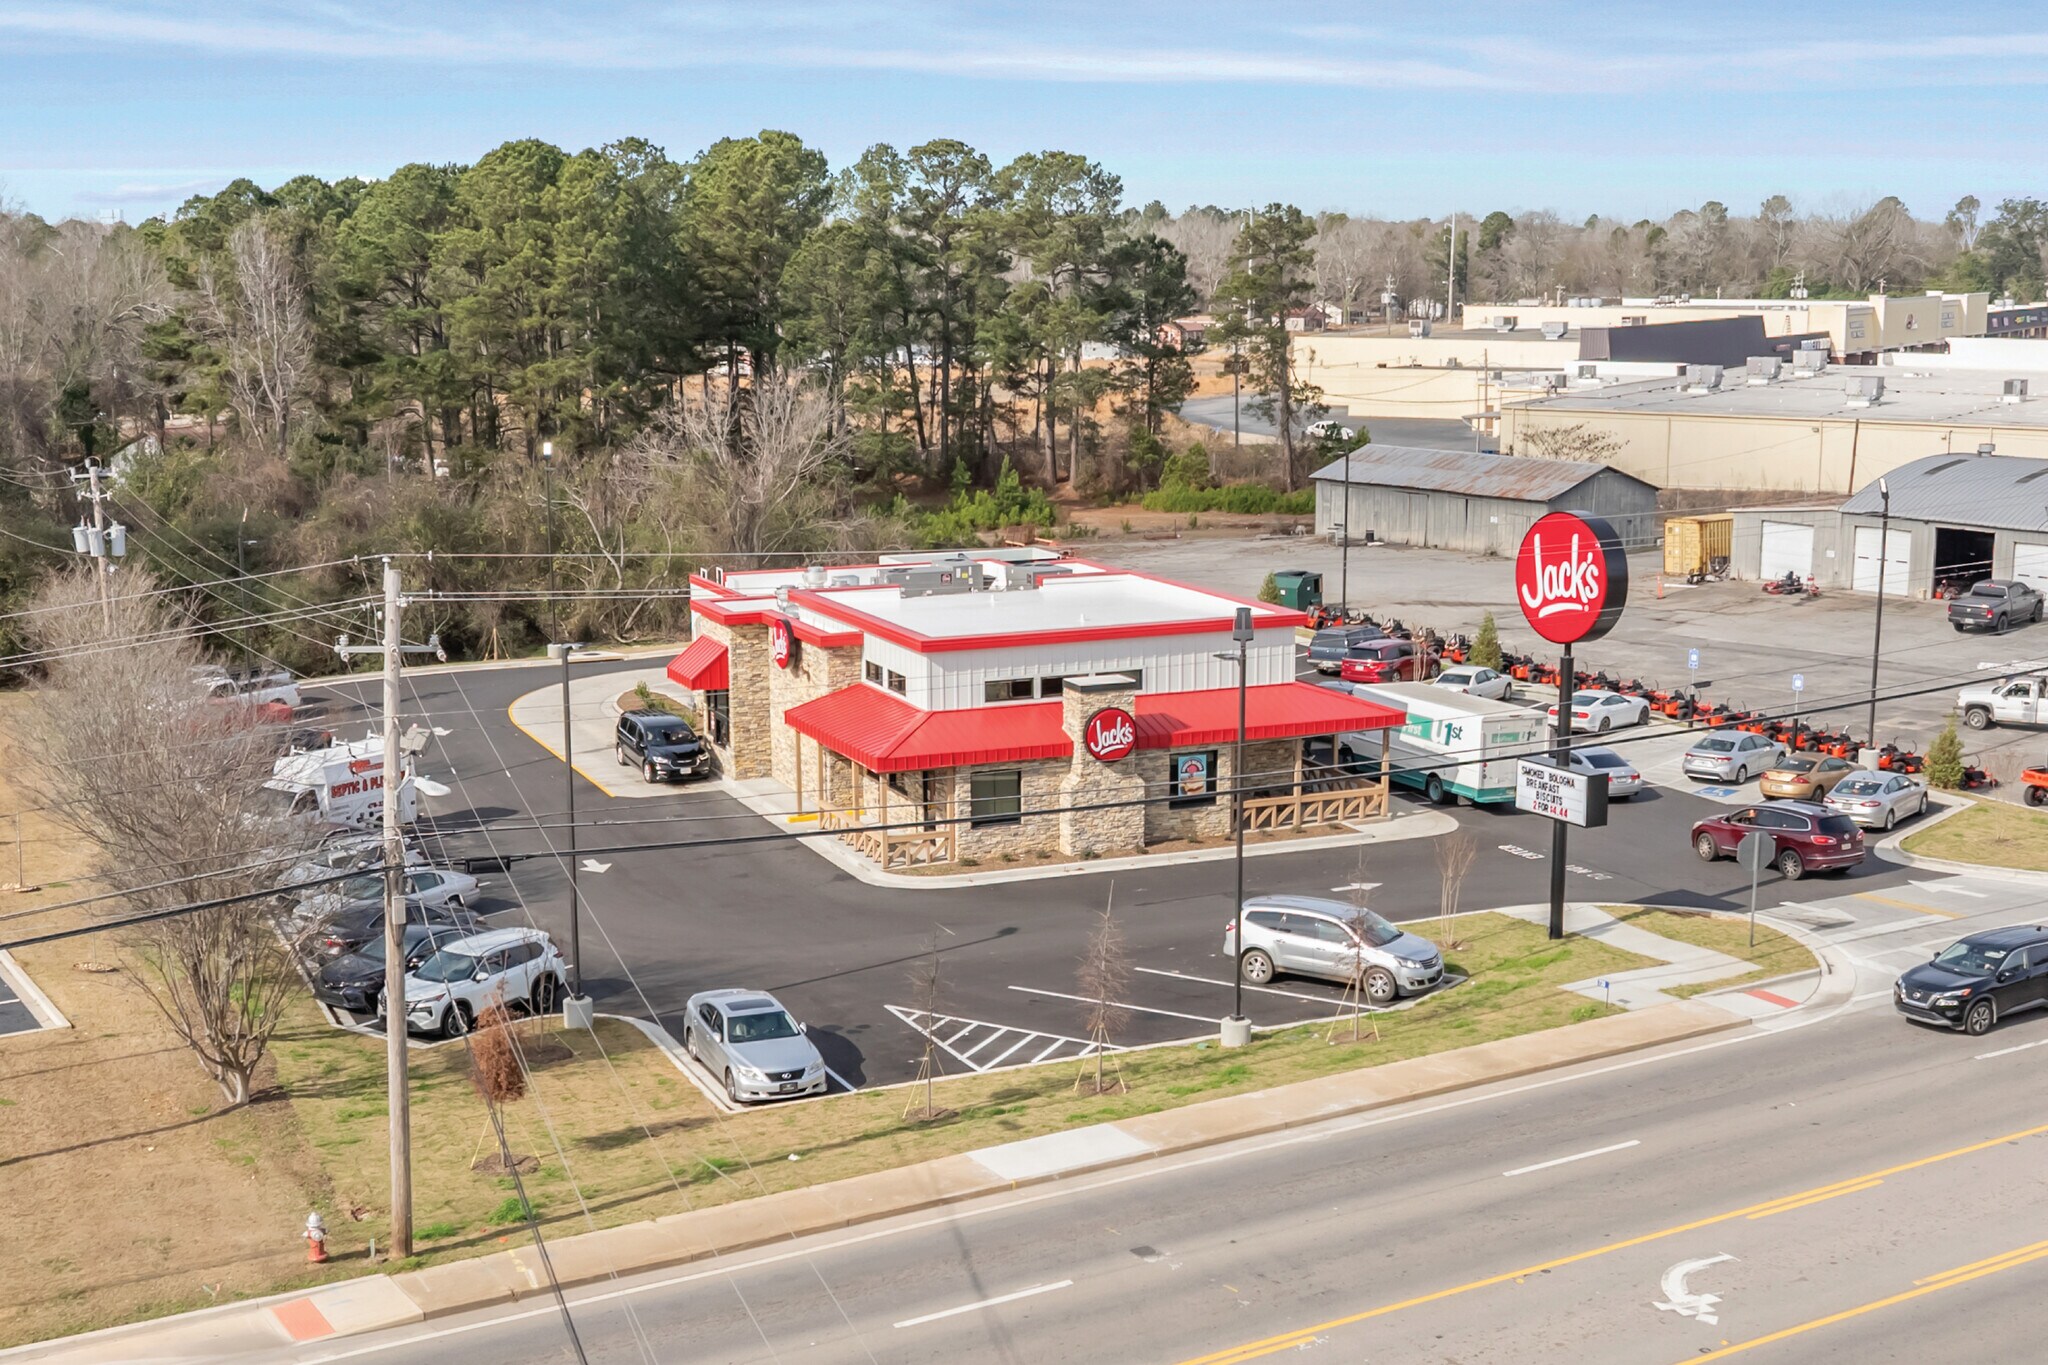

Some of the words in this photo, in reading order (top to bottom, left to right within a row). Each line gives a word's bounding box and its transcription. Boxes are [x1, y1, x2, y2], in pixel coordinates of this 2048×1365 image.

[1521, 533, 1599, 609] Jack's
[1090, 716, 1134, 753] Jack's
[1521, 766, 1545, 779] SMOKED
[1549, 773, 1575, 788] BOLOGNA
[1526, 778, 1560, 794] BREAKFAST
[331, 780, 360, 798] SEPTIC
[1536, 791, 1563, 806] BISCUITS
[1533, 800, 1537, 810] 2
[1538, 802, 1549, 813] FOR
[1550, 805, 1568, 818] $4.44
